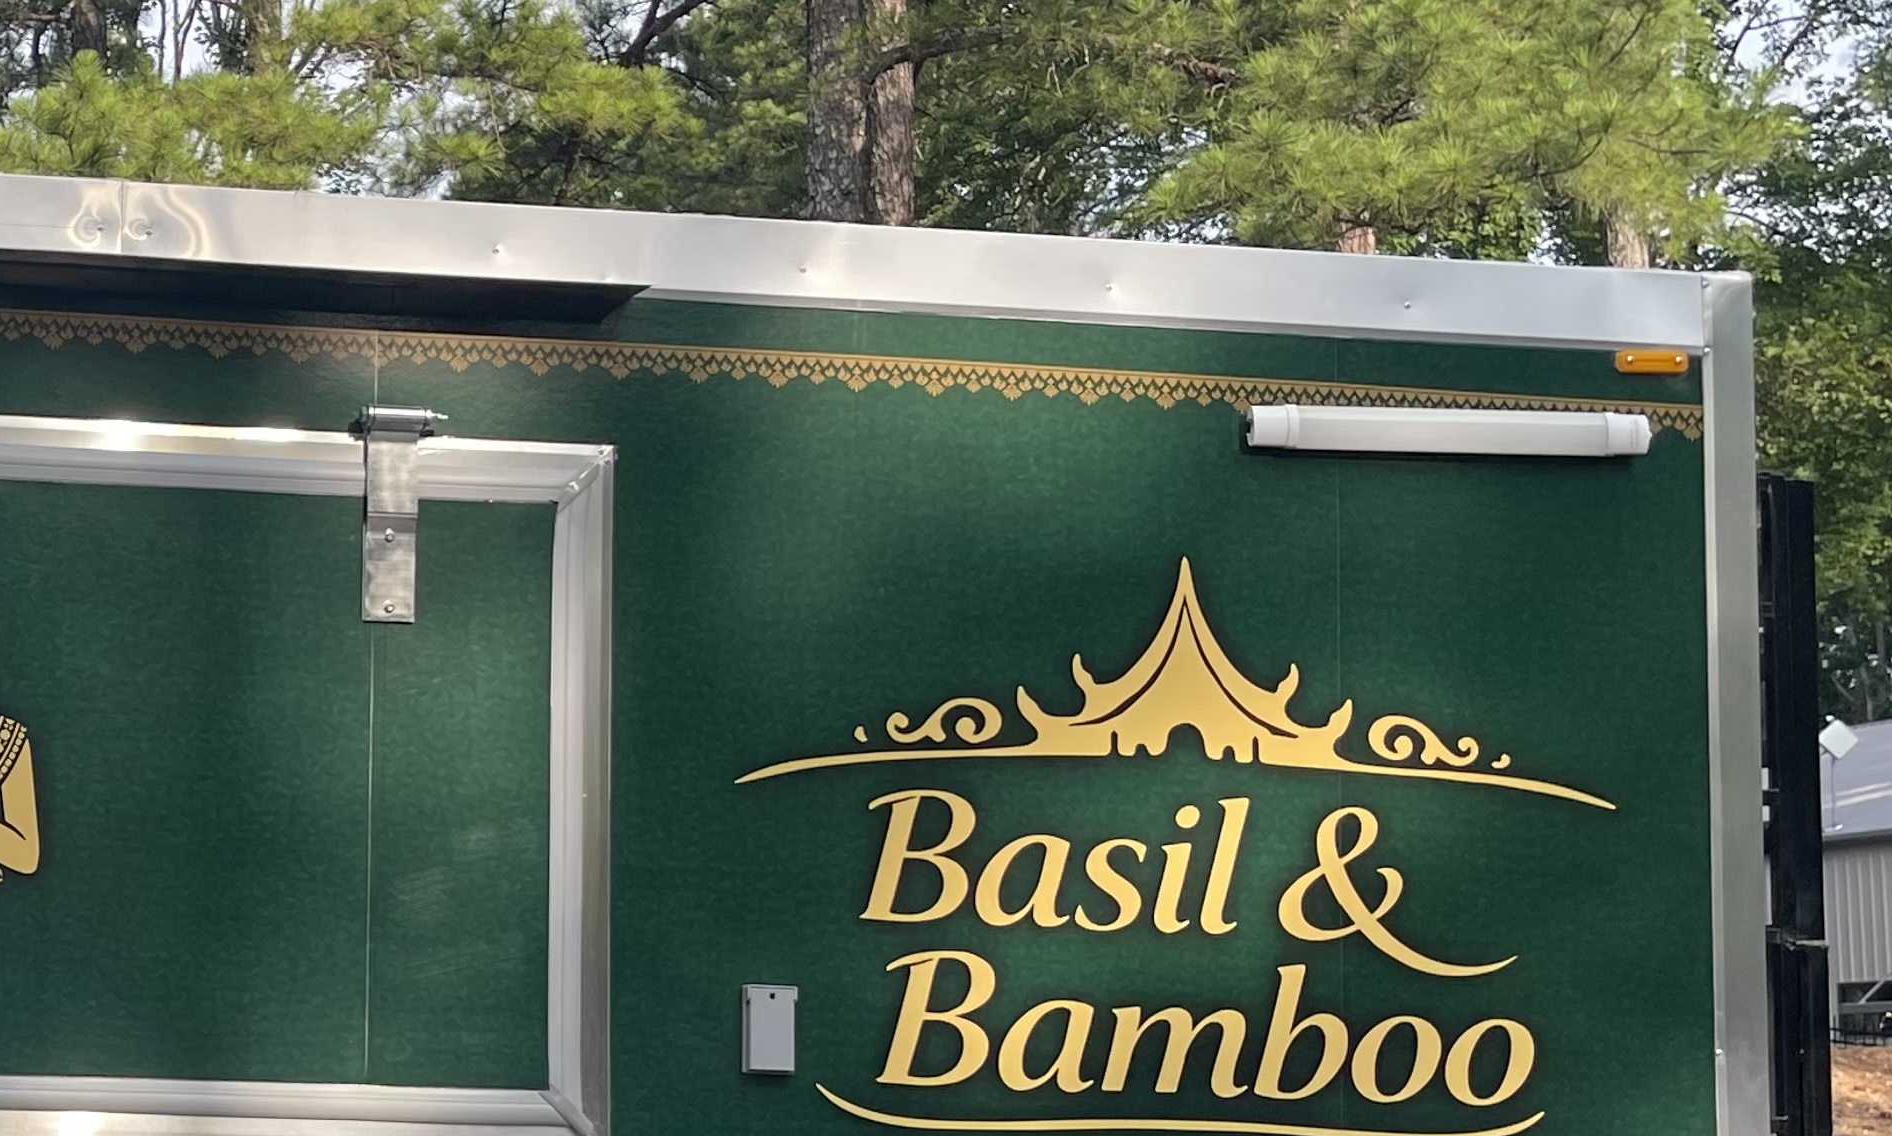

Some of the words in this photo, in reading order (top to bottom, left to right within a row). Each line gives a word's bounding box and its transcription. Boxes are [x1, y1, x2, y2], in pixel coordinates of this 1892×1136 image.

[858, 788, 1251, 936] Basil
[1277, 805, 1519, 978] &
[874, 949, 1536, 1107] Bamboo
